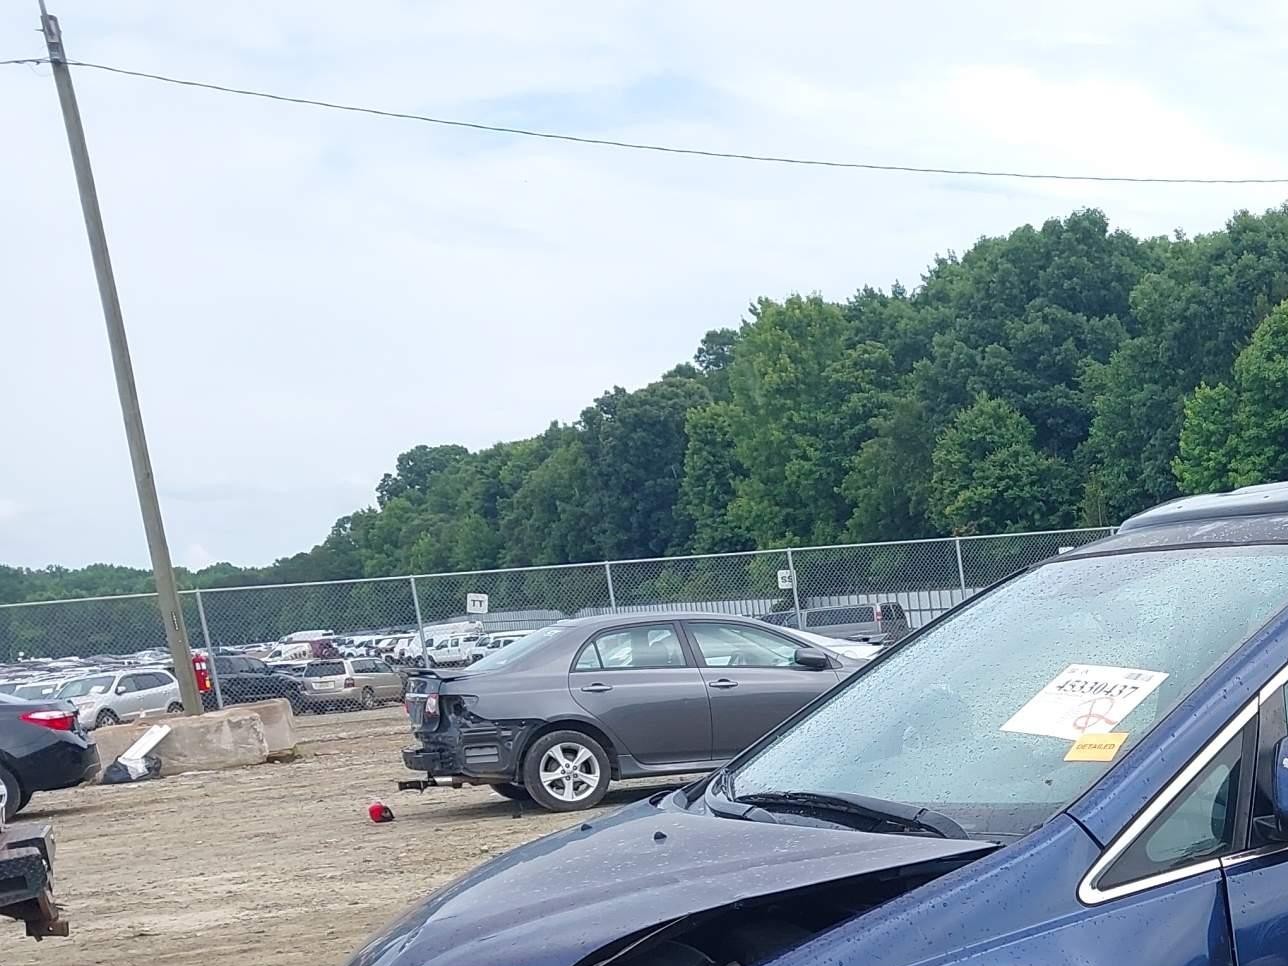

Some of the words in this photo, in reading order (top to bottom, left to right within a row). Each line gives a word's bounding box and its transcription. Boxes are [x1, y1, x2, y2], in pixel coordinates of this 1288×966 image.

[470, 599, 484, 608] TT
[1055, 679, 1141, 699] 45330437
[1075, 743, 1116, 751] DETAILED
